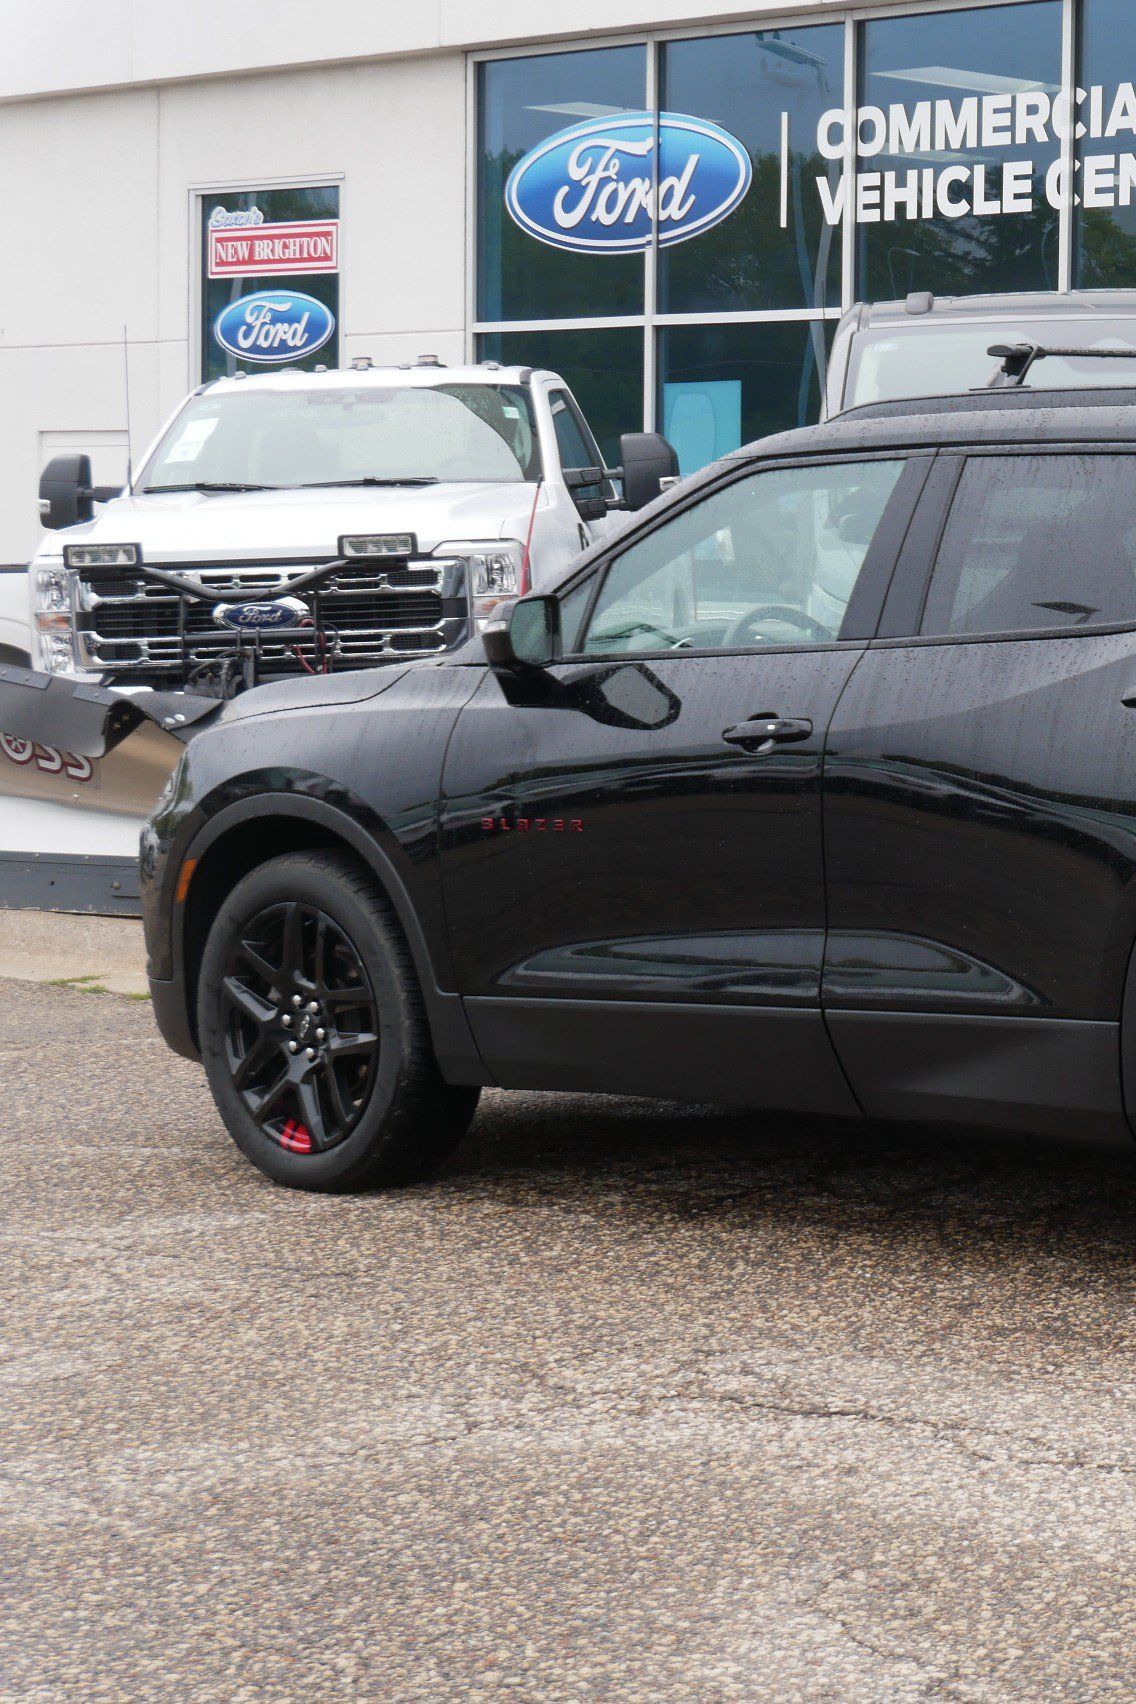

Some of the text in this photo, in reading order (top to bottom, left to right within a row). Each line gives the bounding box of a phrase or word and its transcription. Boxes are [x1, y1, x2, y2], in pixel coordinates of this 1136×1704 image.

[553, 137, 699, 228] Ford
[815, 160, 1034, 226] VEHICLE
[216, 236, 333, 263] NEW BRIGHTON
[238, 301, 311, 349] Ford
[239, 606, 282, 623] Ford
[482, 817, 583, 832] BLAZER
